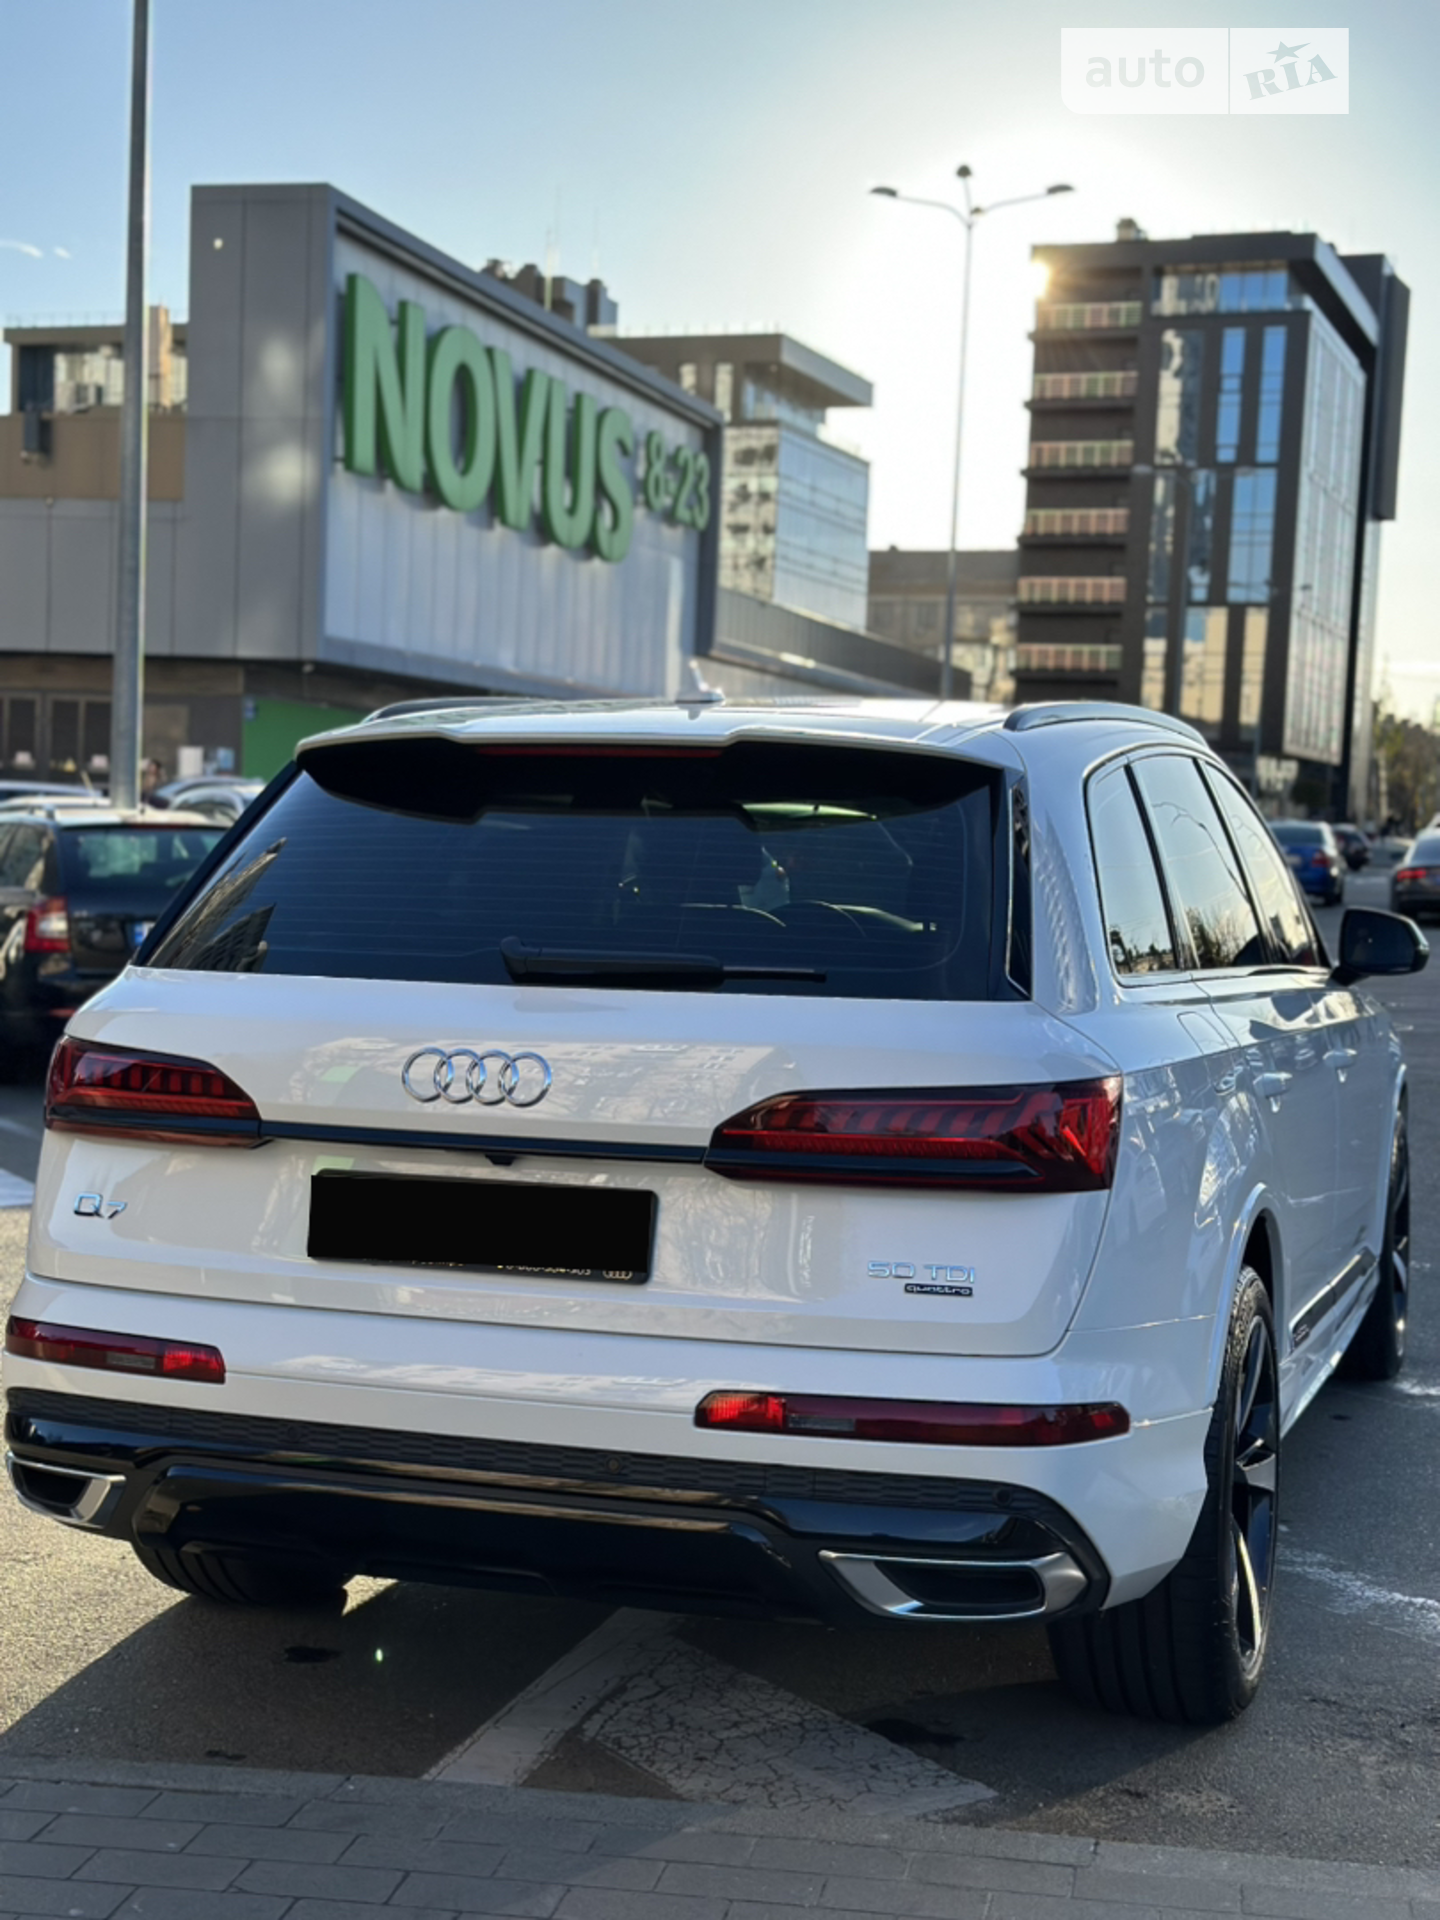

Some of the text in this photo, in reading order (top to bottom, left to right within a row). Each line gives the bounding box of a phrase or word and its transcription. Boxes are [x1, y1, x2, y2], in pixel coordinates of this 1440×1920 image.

[344, 272, 635, 564] NOVUS
[73, 1192, 128, 1220] Q7
[867, 1261, 975, 1284] 50 TDI
[905, 1284, 972, 1296] quattro
